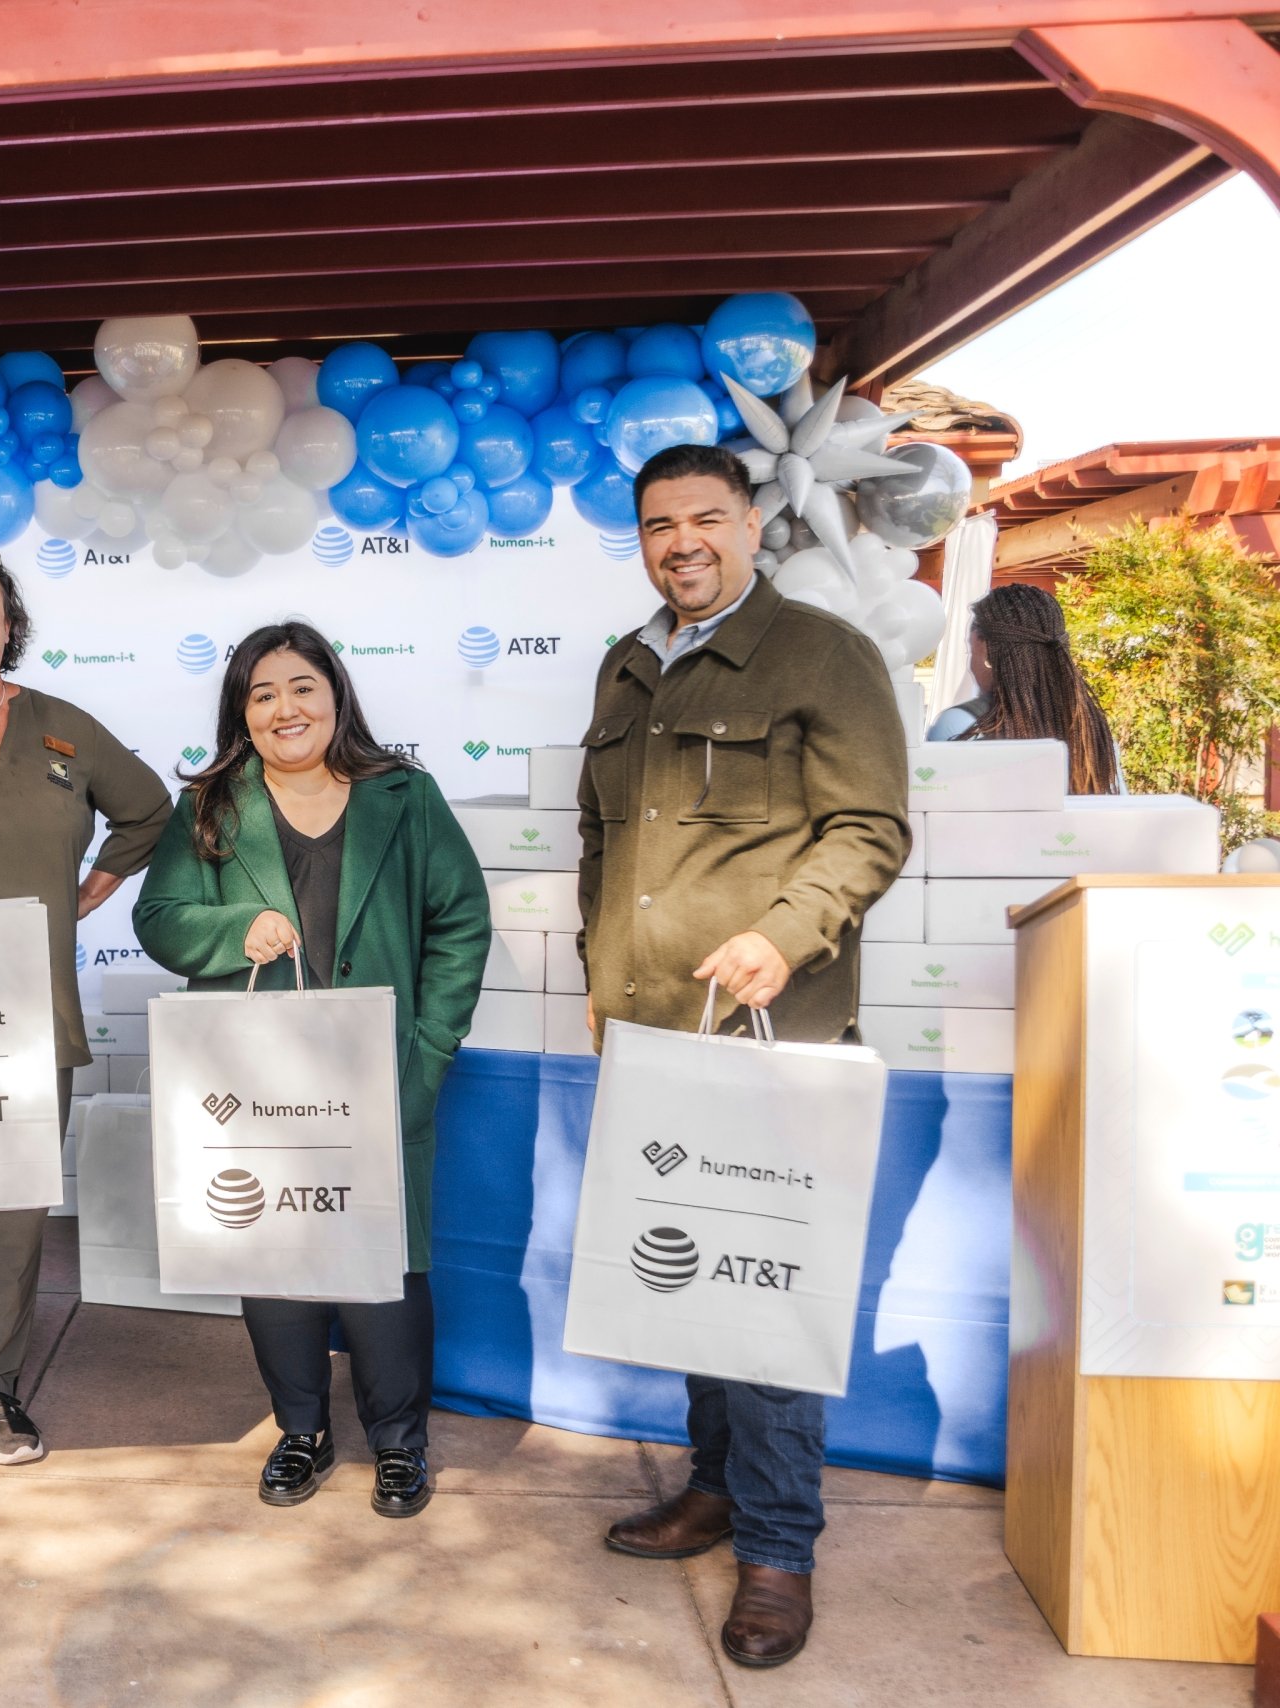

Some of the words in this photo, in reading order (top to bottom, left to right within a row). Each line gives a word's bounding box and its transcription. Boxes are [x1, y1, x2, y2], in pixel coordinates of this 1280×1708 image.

[490, 536, 556, 548] human-i-t
[351, 644, 415, 656] human-i-t
[507, 637, 561, 655] AT&T
[74, 652, 135, 664] human-i-t
[380, 743, 420, 760] T&T
[509, 843, 552, 852] human-i-t
[911, 979, 959, 988] human-i-t
[252, 1100, 351, 1117] human-i-t
[699, 1155, 814, 1189] human-i-t
[275, 1186, 352, 1213] AT&T
[710, 1253, 801, 1291] AT&T
